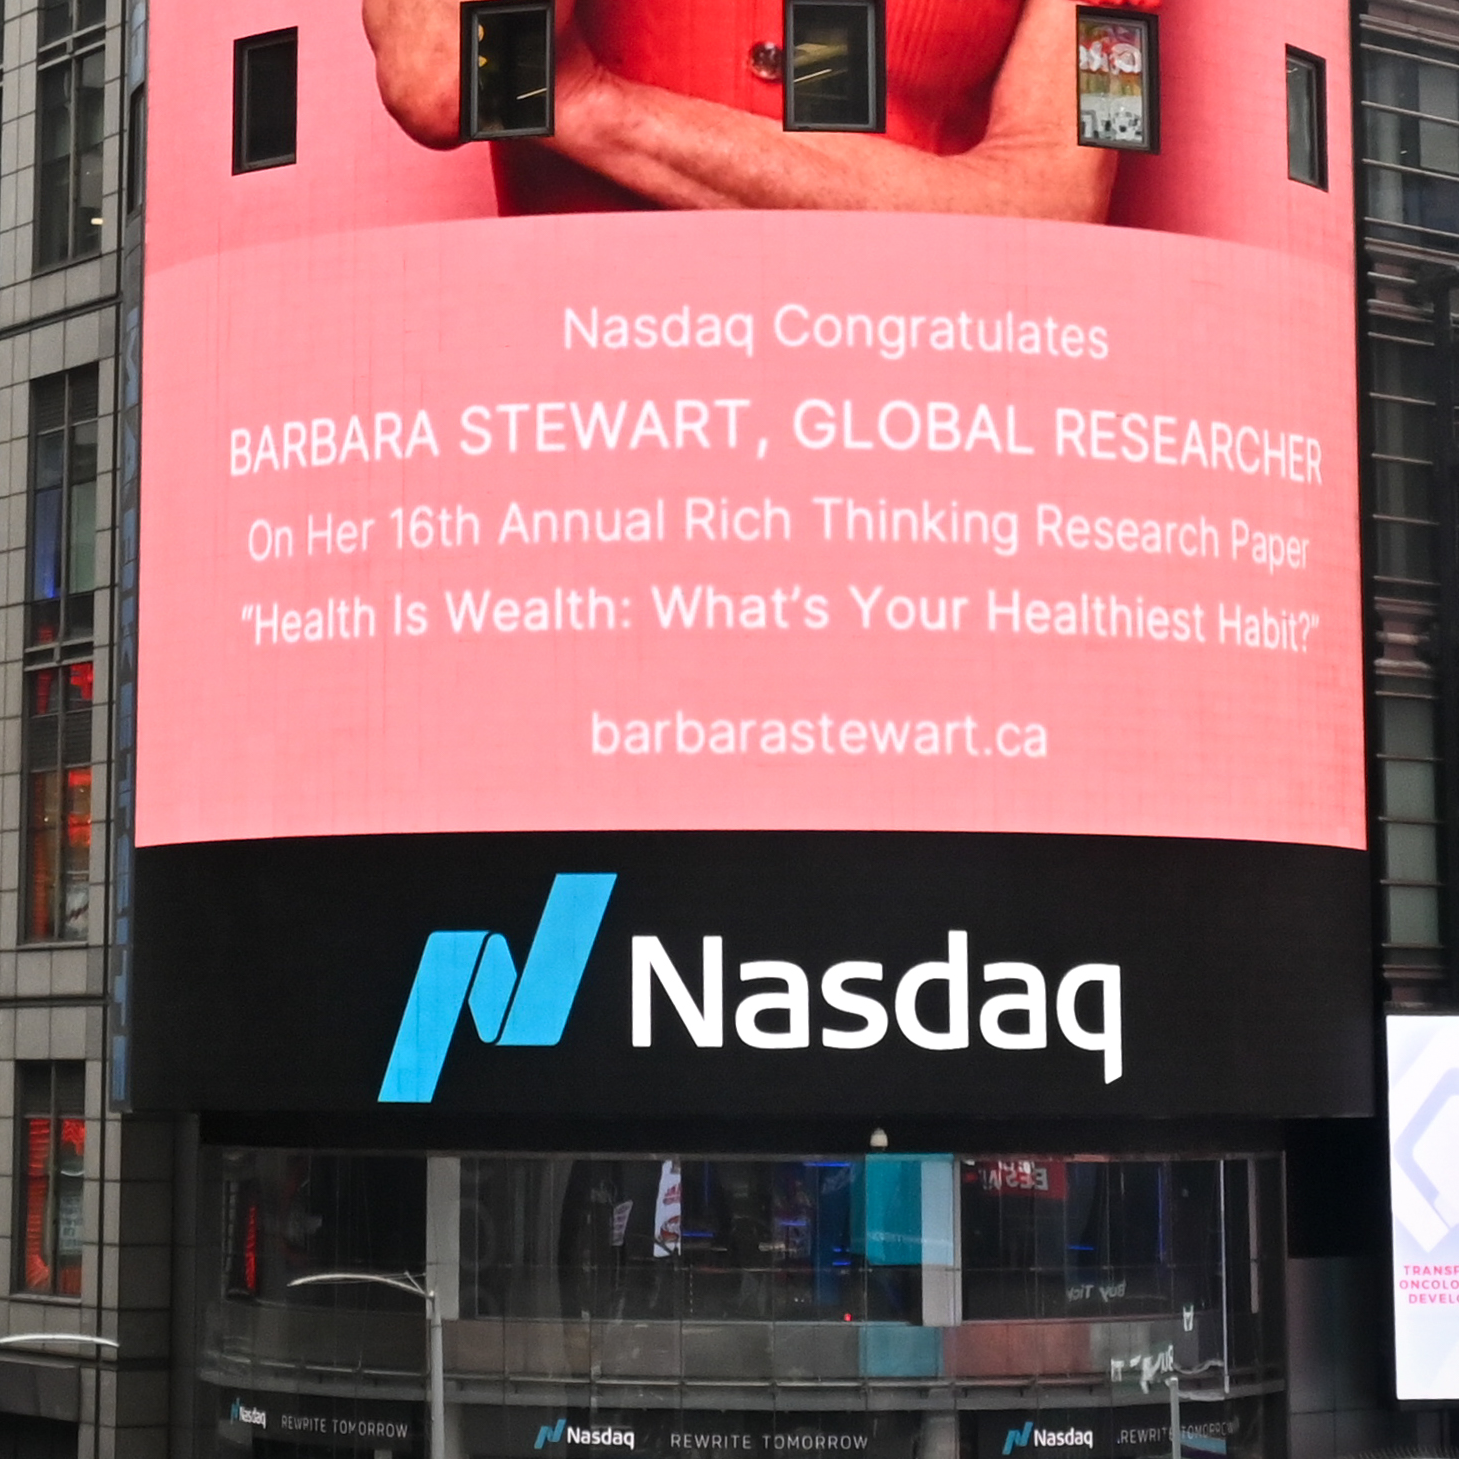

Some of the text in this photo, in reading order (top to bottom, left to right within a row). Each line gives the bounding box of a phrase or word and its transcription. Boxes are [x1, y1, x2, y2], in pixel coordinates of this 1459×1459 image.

[564, 304, 1109, 361] Nasdaq Congratulates
[230, 399, 1322, 484] BARBARA STEWART, GLOBAL RESEARCHER
[247, 497, 1310, 571] On Her 16th Annual Rich Thinking Research Paper
[241, 597, 376, 646] "Health
[394, 594, 429, 636] Is
[444, 587, 630, 633] Wealth:
[651, 585, 830, 630] What's
[848, 585, 969, 631] Your
[987, 589, 1206, 643] Healthiest
[591, 710, 1048, 758] barbarastewart.ca
[631, 929, 1124, 1085] Nasdaq
[239, 1405, 408, 1438] Nasdaq REWRITE TOMORROW
[567, 1426, 868, 1450] Nasdaq REWRITE TOMORROW
[1033, 1427, 1093, 1449] Nasdaq
